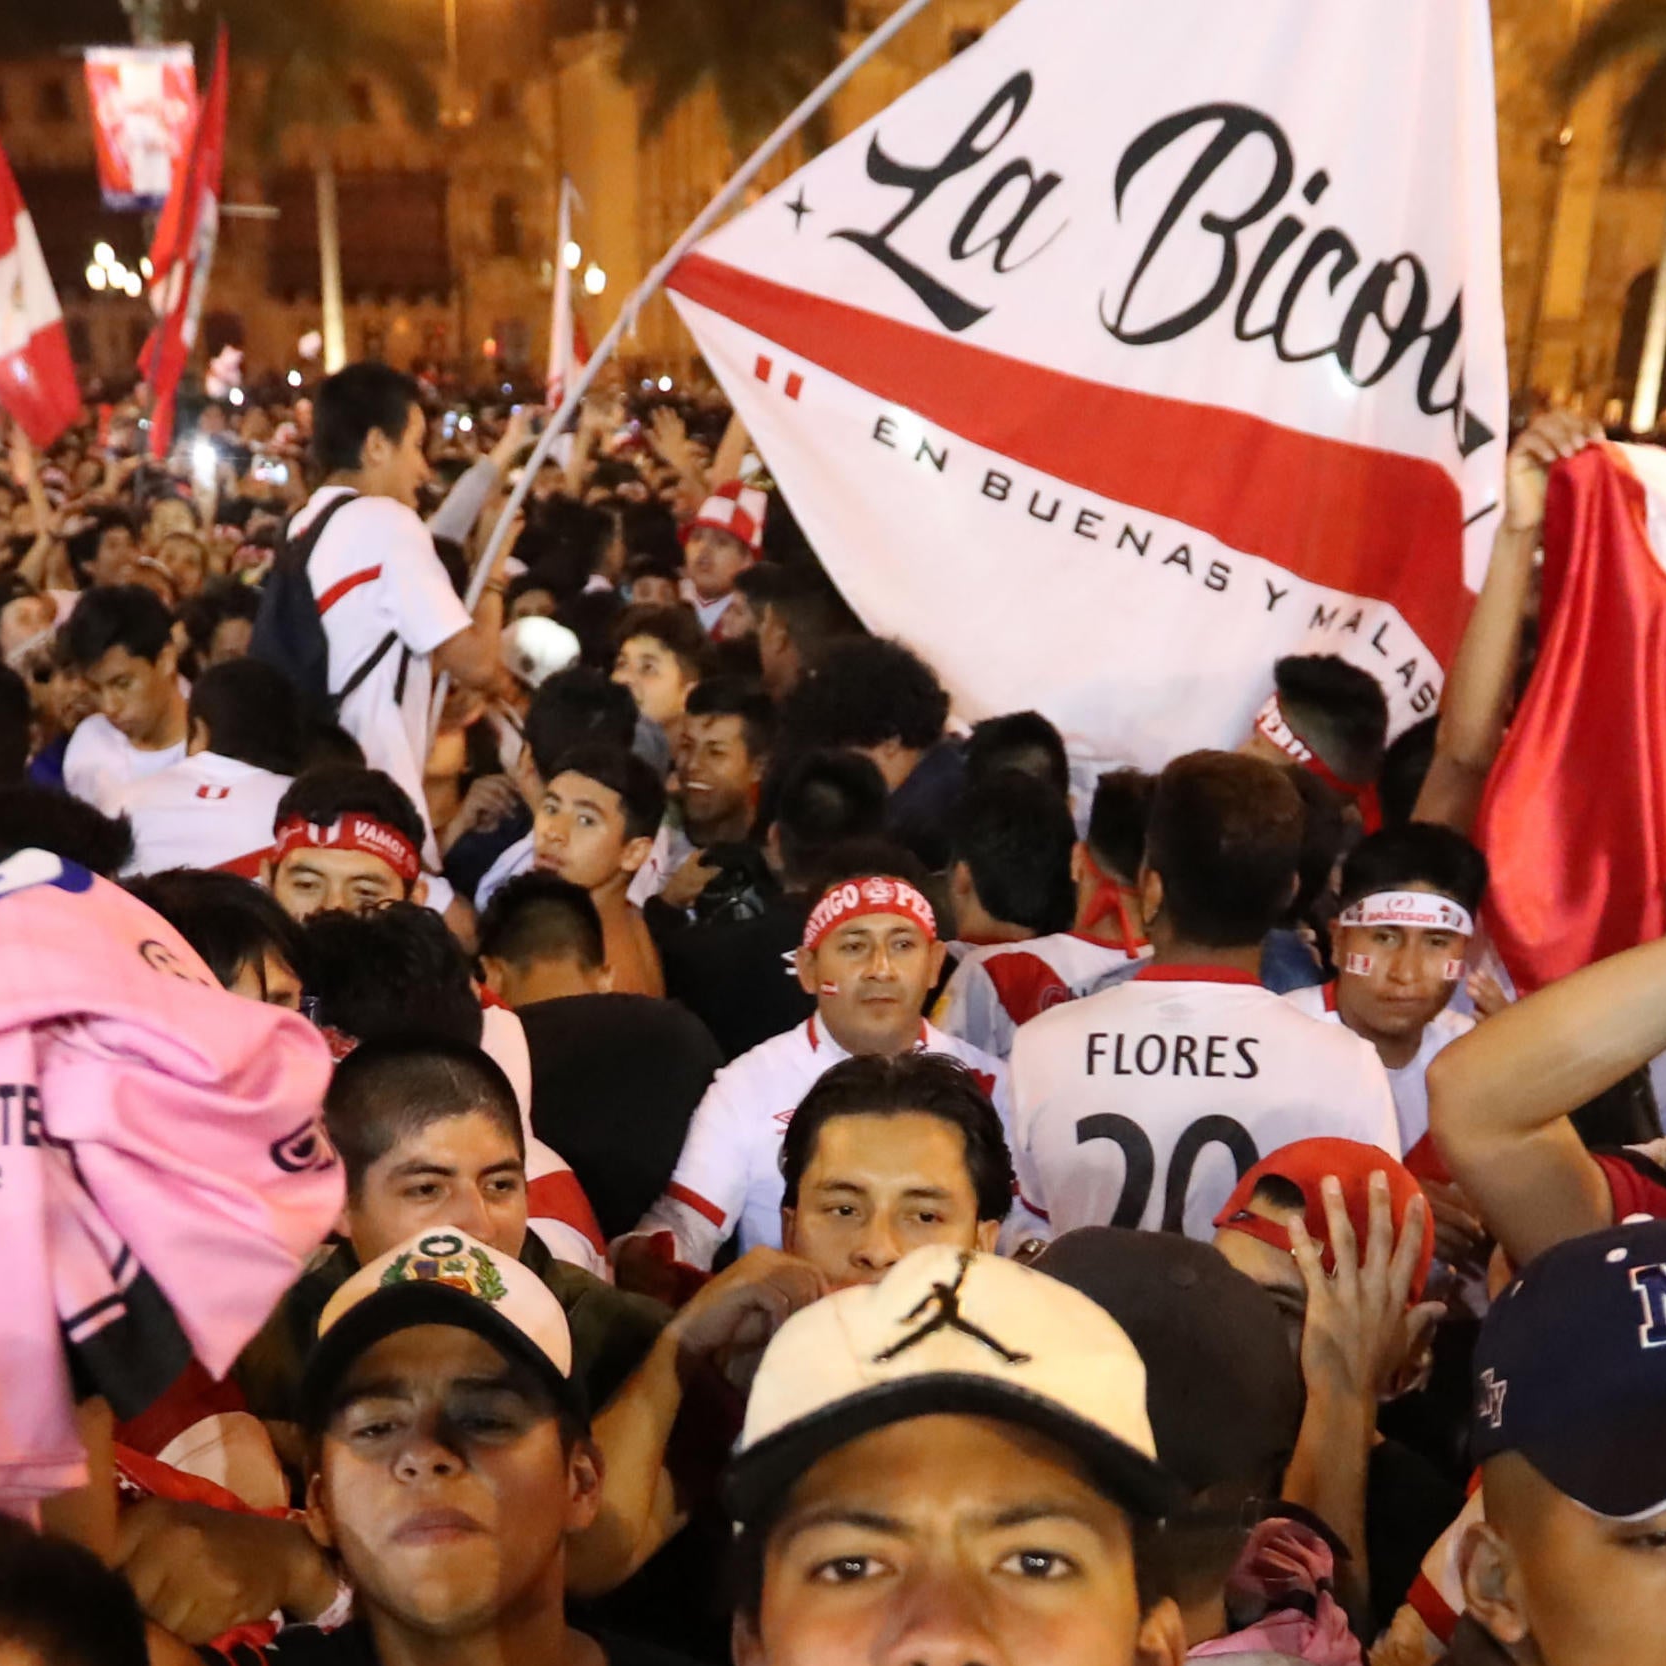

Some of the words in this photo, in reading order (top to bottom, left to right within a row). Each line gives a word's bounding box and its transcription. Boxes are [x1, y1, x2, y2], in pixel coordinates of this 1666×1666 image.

[828, 69, 1069, 332] La
[872, 415, 949, 475] EN
[981, 468, 1234, 592] BUENAS
[1263, 577, 1289, 613] Y
[1308, 604, 1437, 716] MALAS
[803, 884, 860, 947] NTIGO
[894, 881, 937, 939] PE
[1086, 1032, 1260, 1079] FLORES
[1075, 1112, 1260, 1238] 20
